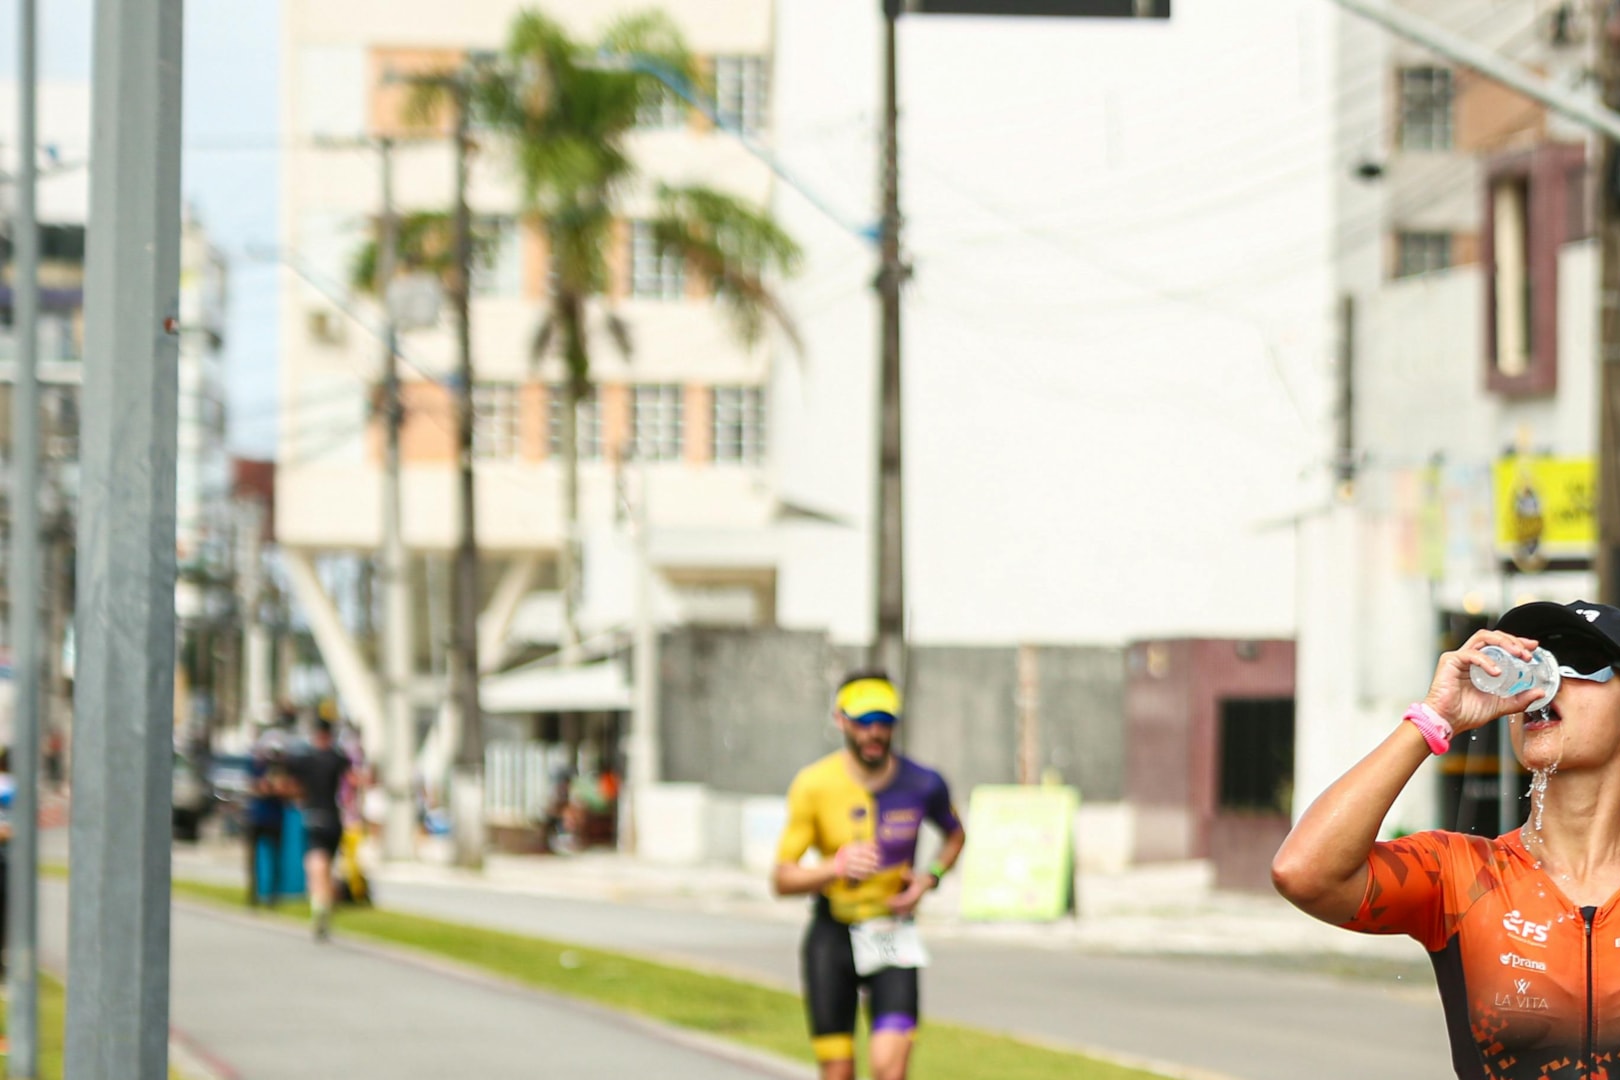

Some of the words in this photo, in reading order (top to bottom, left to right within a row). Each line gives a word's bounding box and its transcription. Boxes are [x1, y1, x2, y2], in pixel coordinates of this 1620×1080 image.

[1511, 954, 1546, 970] prana
[1495, 992, 1511, 1007] LA
[1516, 995, 1548, 1009] VITA
